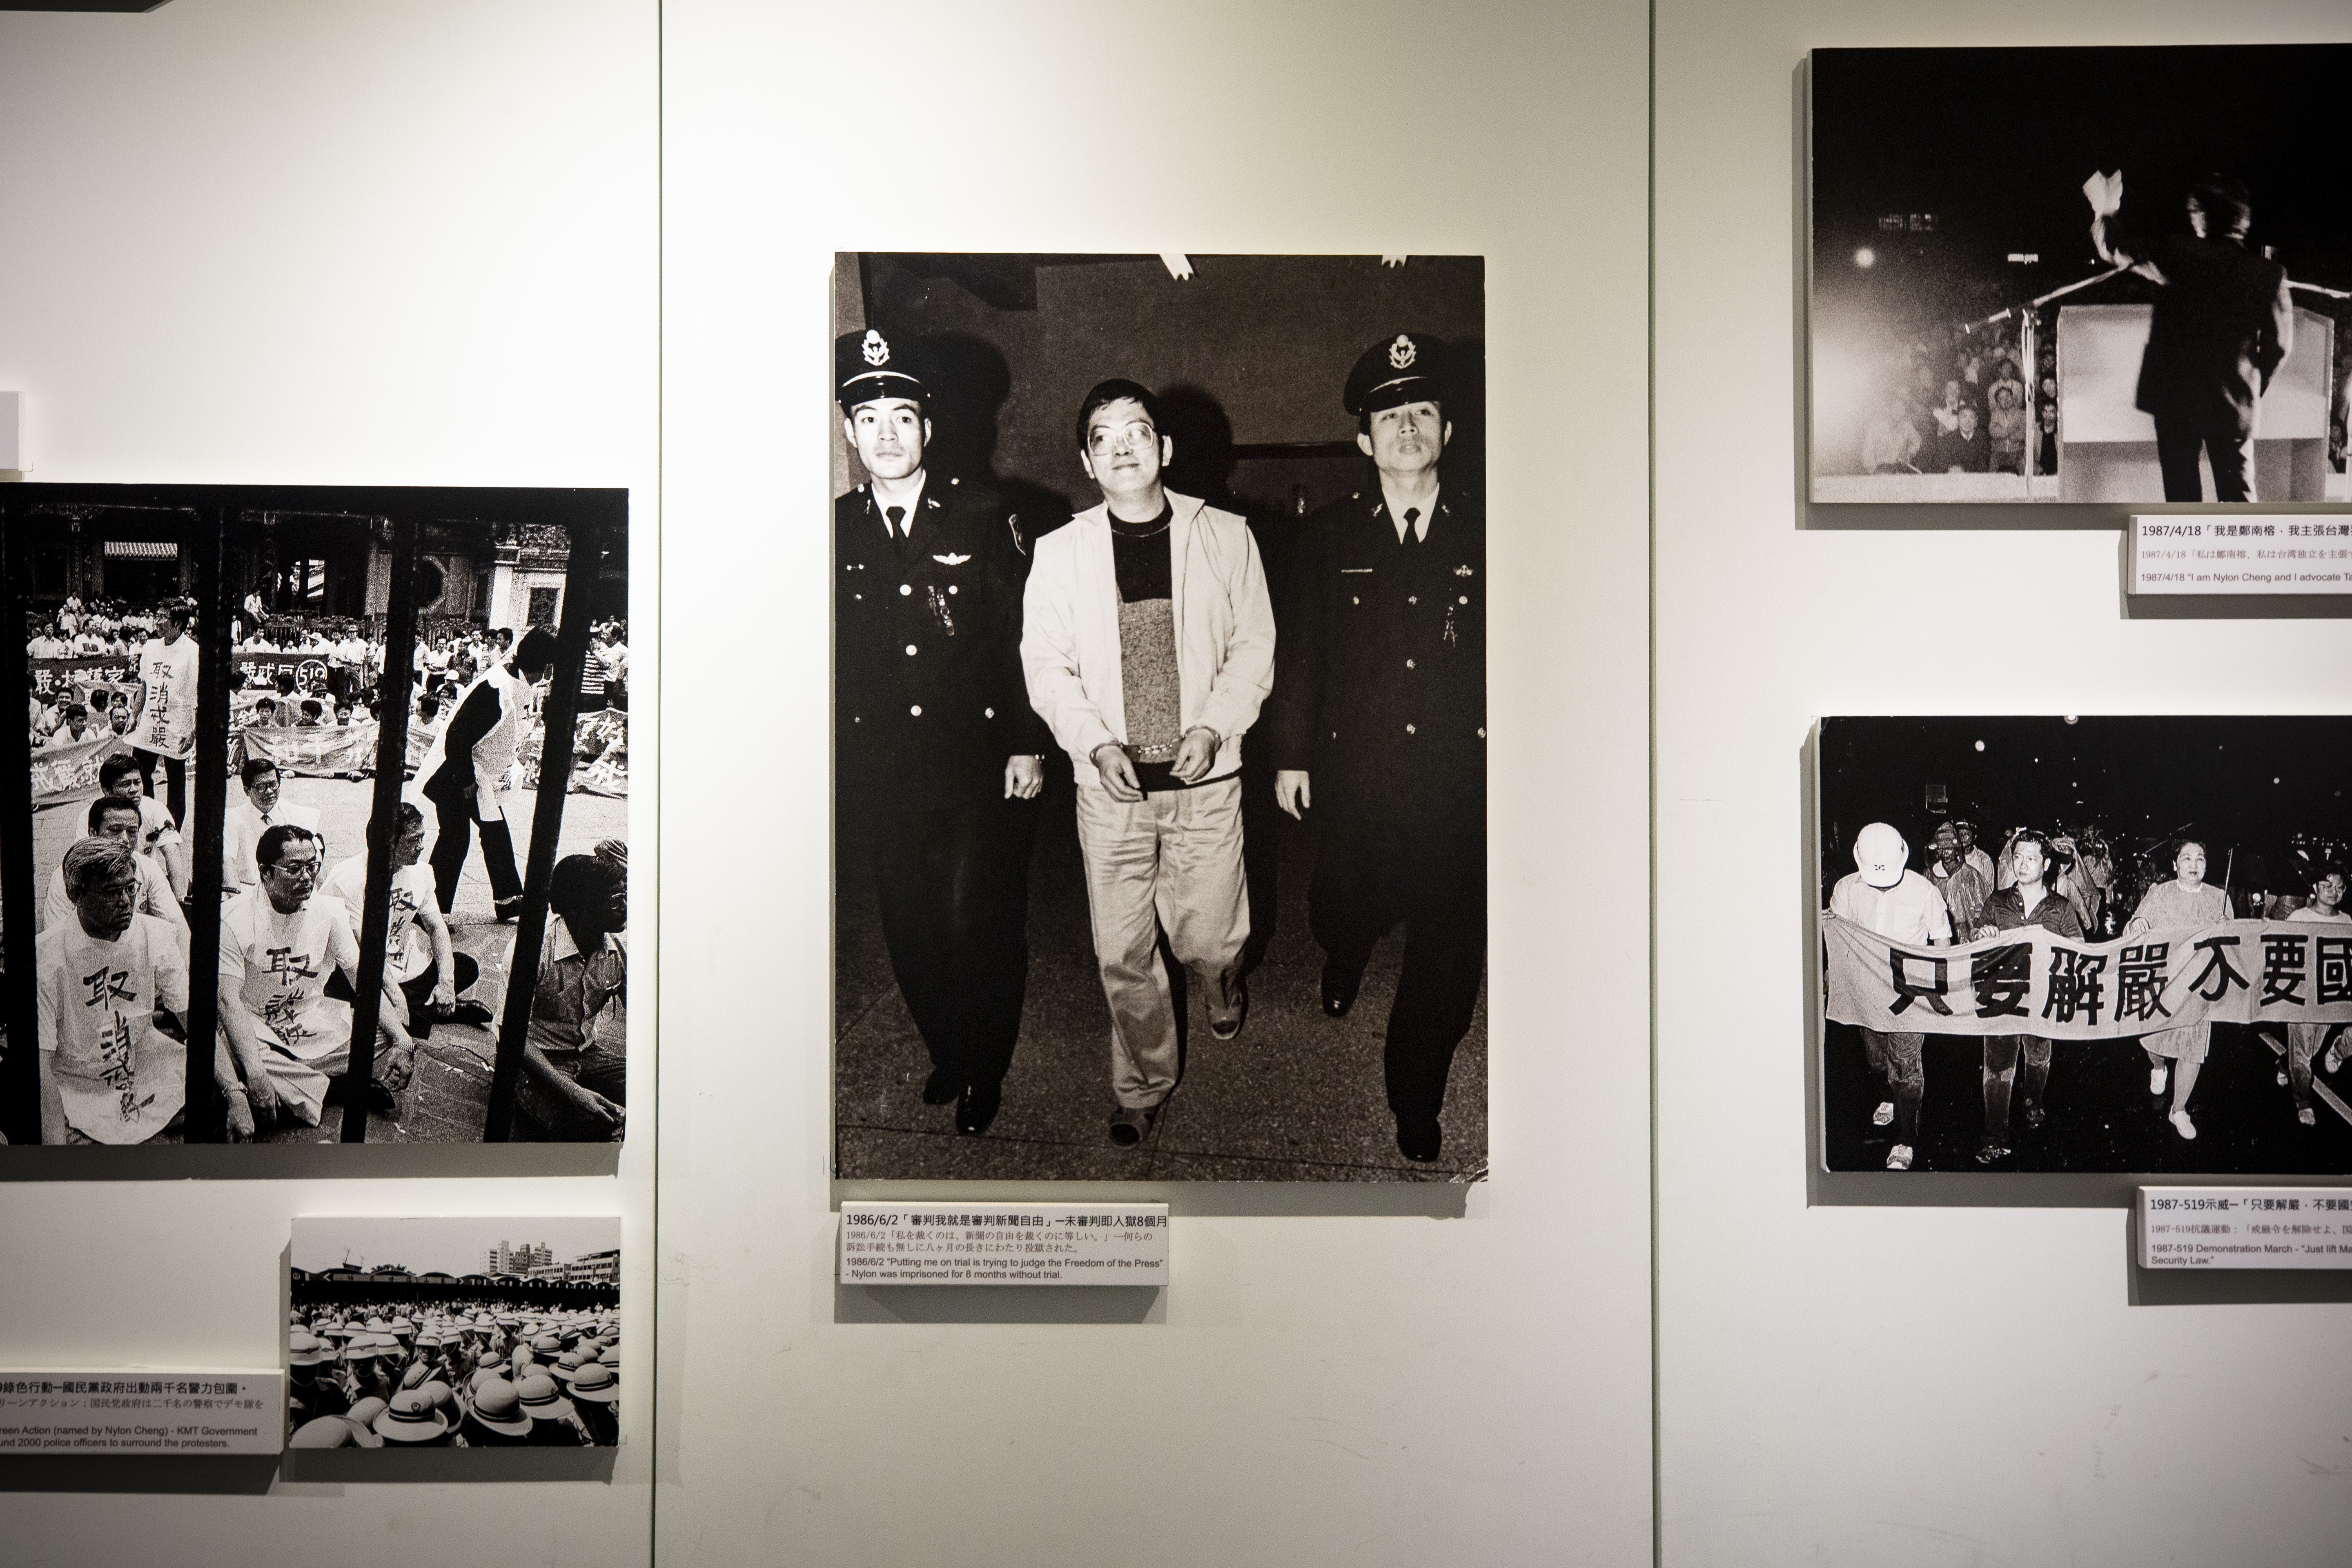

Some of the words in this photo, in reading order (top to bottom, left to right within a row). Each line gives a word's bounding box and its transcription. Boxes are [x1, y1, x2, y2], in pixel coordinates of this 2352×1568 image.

[2214, 573, 2239, 583] Nylon
[2242, 573, 2272, 583] Cheng
[2152, 1244, 2193, 1252] 1987-519
[2196, 1244, 2262, 1253] Demonstration
[2265, 1244, 2293, 1253] March
[2326, 1244, 2337, 1253] lift
[846, 1257, 884, 1266] 1986/6/2
[954, 1258, 971, 1266] trial
[973, 1258, 980, 1266] is
[983, 1258, 1007, 1269] trying
[1020, 1258, 1046, 1269] judge
[1048, 1258, 1062, 1267] the
[1065, 1258, 1105, 1267] Freedom
[1107, 1258, 1116, 1267] of
[1118, 1259, 1132, 1267] the
[2152, 1256, 2187, 1266] Security
[852, 1269, 877, 1280] Nylon
[900, 1269, 949, 1280] imprisoned
[951, 1270, 964, 1278] for
[966, 1270, 971, 1278] 8
[974, 1270, 1007, 1278] months
[1009, 1270, 1041, 1279] without
[1044, 1271, 1062, 1279] trial.
[22, 1426, 50, 1435] Action
[53, 1426, 89, 1436] (named
[91, 1426, 102, 1436] by
[105, 1426, 131, 1437] Nylon
[134, 1426, 168, 1437] Cheng)
[177, 1426, 199, 1435] KMT
[201, 1426, 258, 1436] Government
[18, 1438, 41, 1447] 2000
[44, 1438, 71, 1448] police
[74, 1438, 107, 1447] officers
[121, 1439, 162, 1447] surround
[165, 1439, 179, 1447] the
[182, 1439, 229, 1448] protesters.
